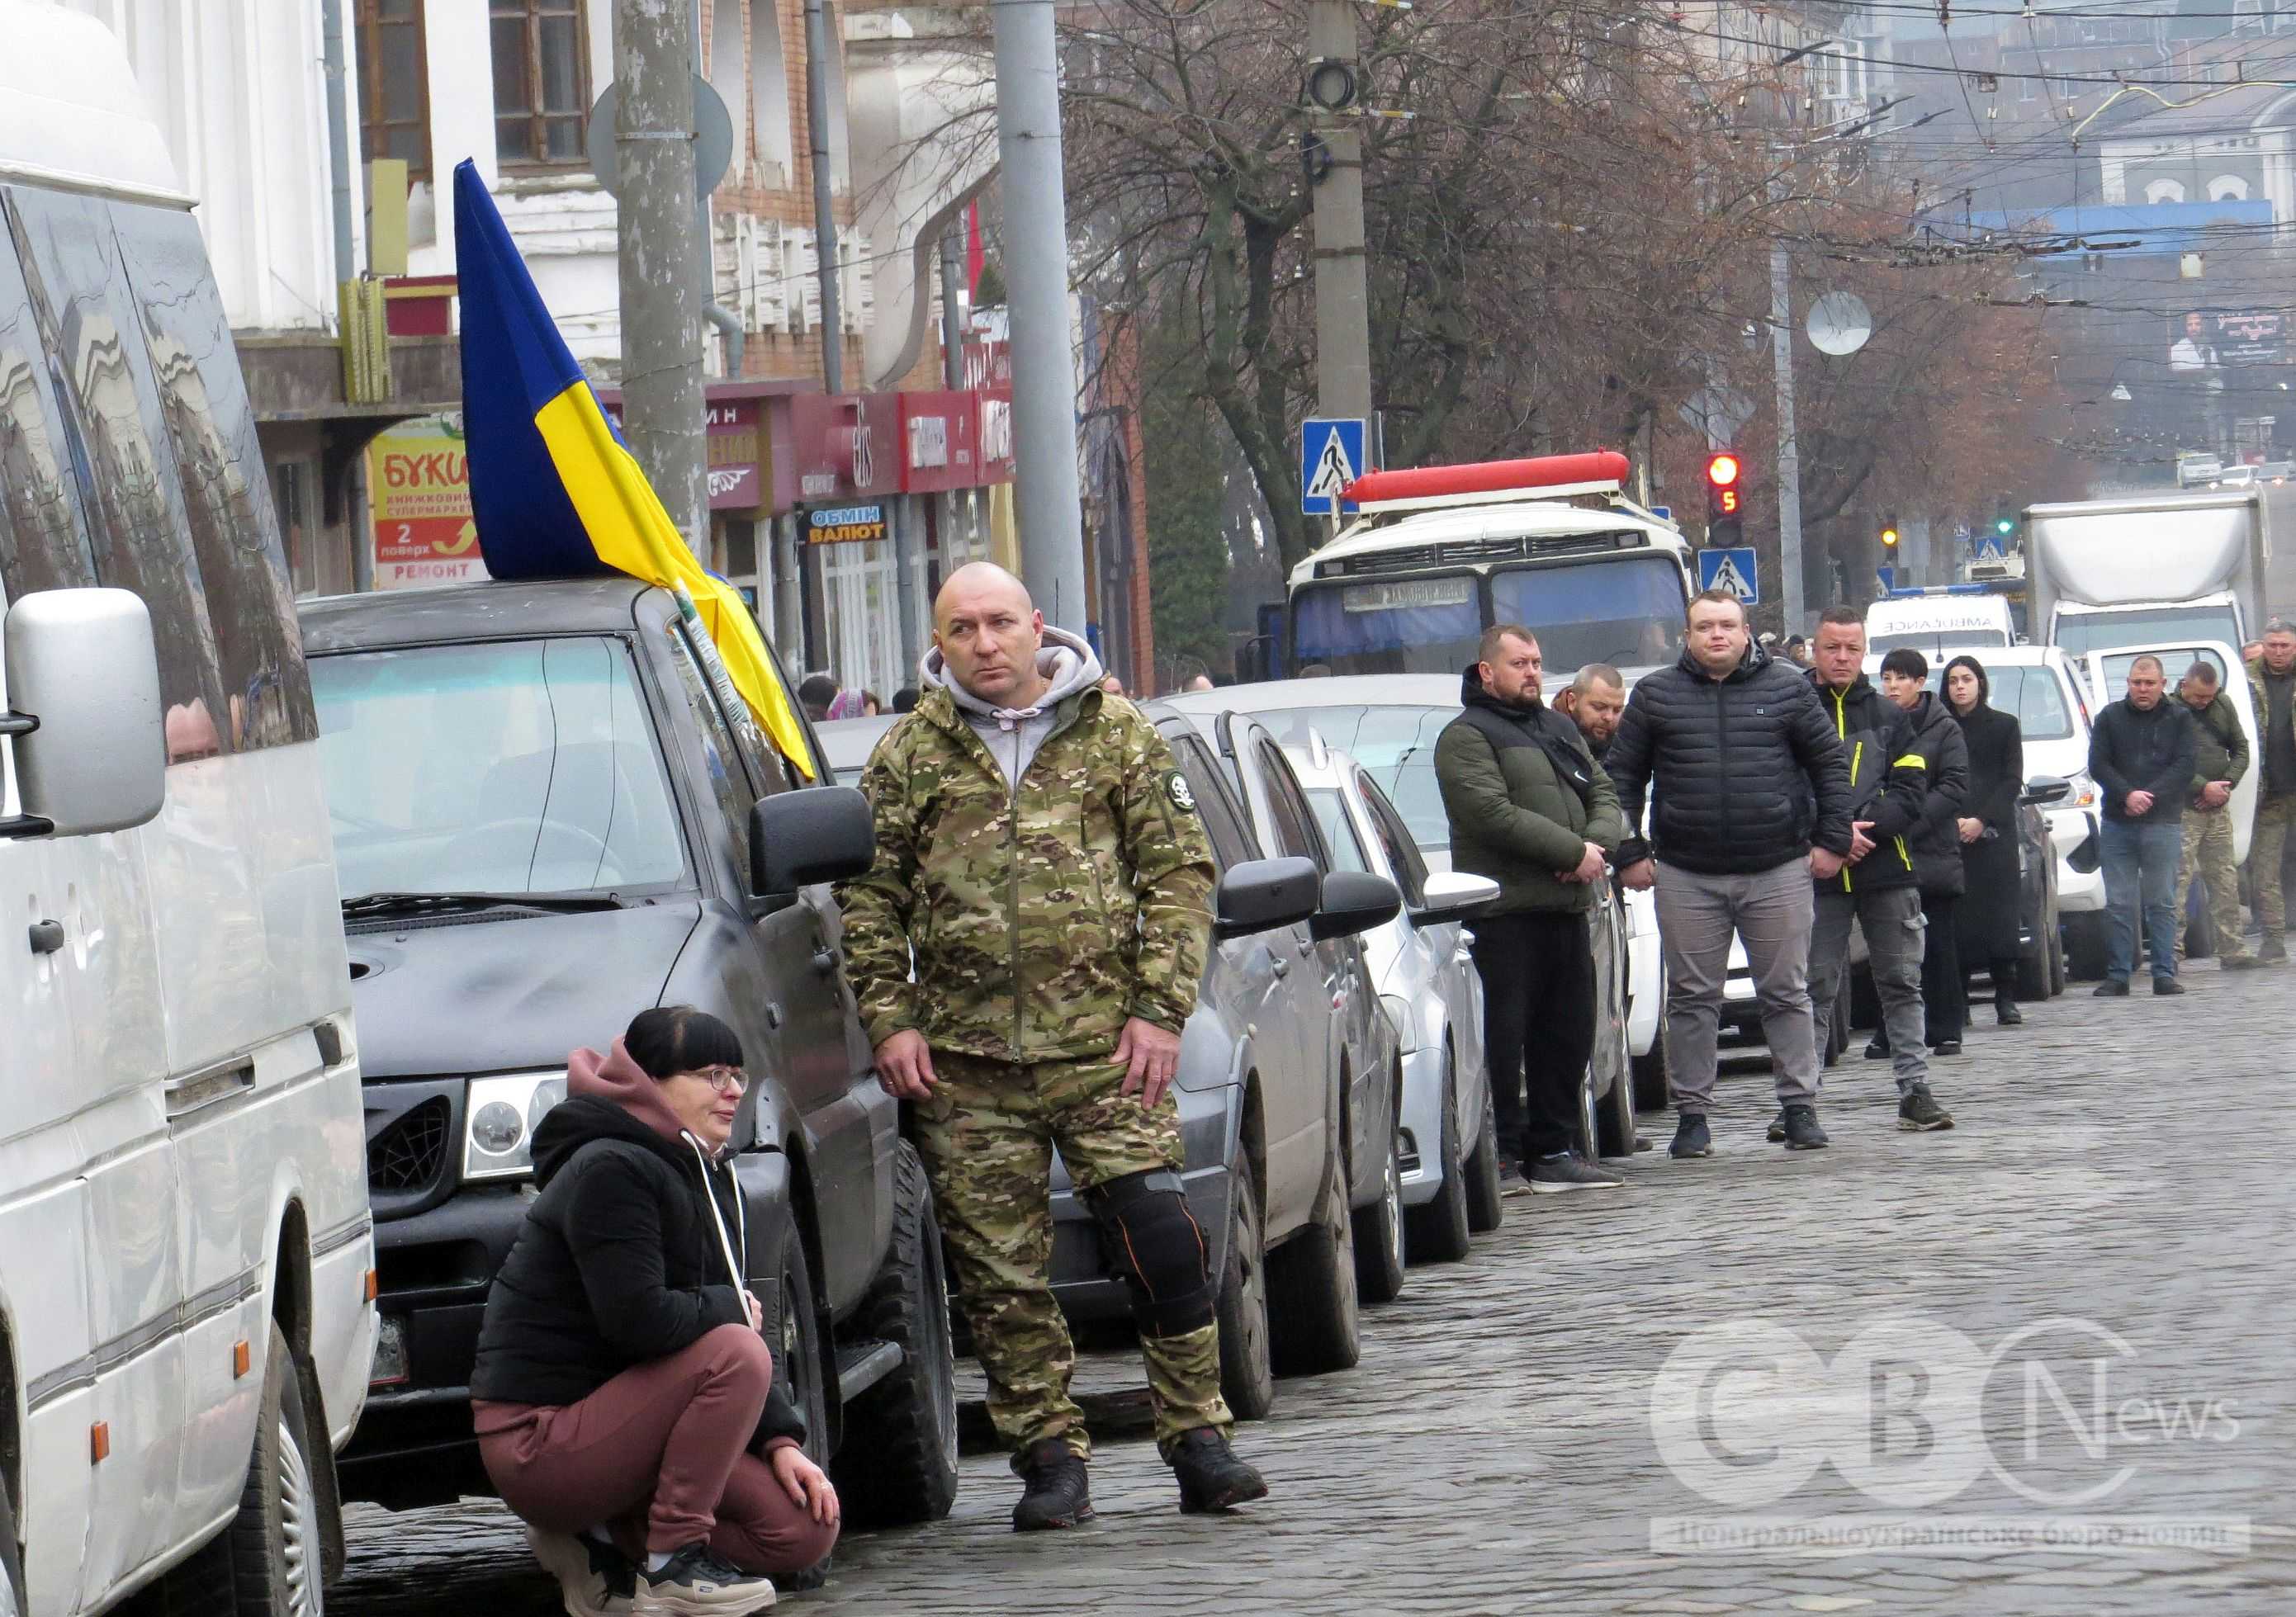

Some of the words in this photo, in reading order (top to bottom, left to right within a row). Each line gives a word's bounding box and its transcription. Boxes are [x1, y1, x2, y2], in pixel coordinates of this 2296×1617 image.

[384, 451, 469, 488] БУКИ
[1723, 490, 1735, 511] 5
[811, 505, 880, 527] ОБМІН
[397, 523, 411, 544] 2
[808, 523, 885, 544] ВАЛЮТ
[381, 544, 430, 558] поверх
[395, 563, 470, 580] РЕМОНТ
